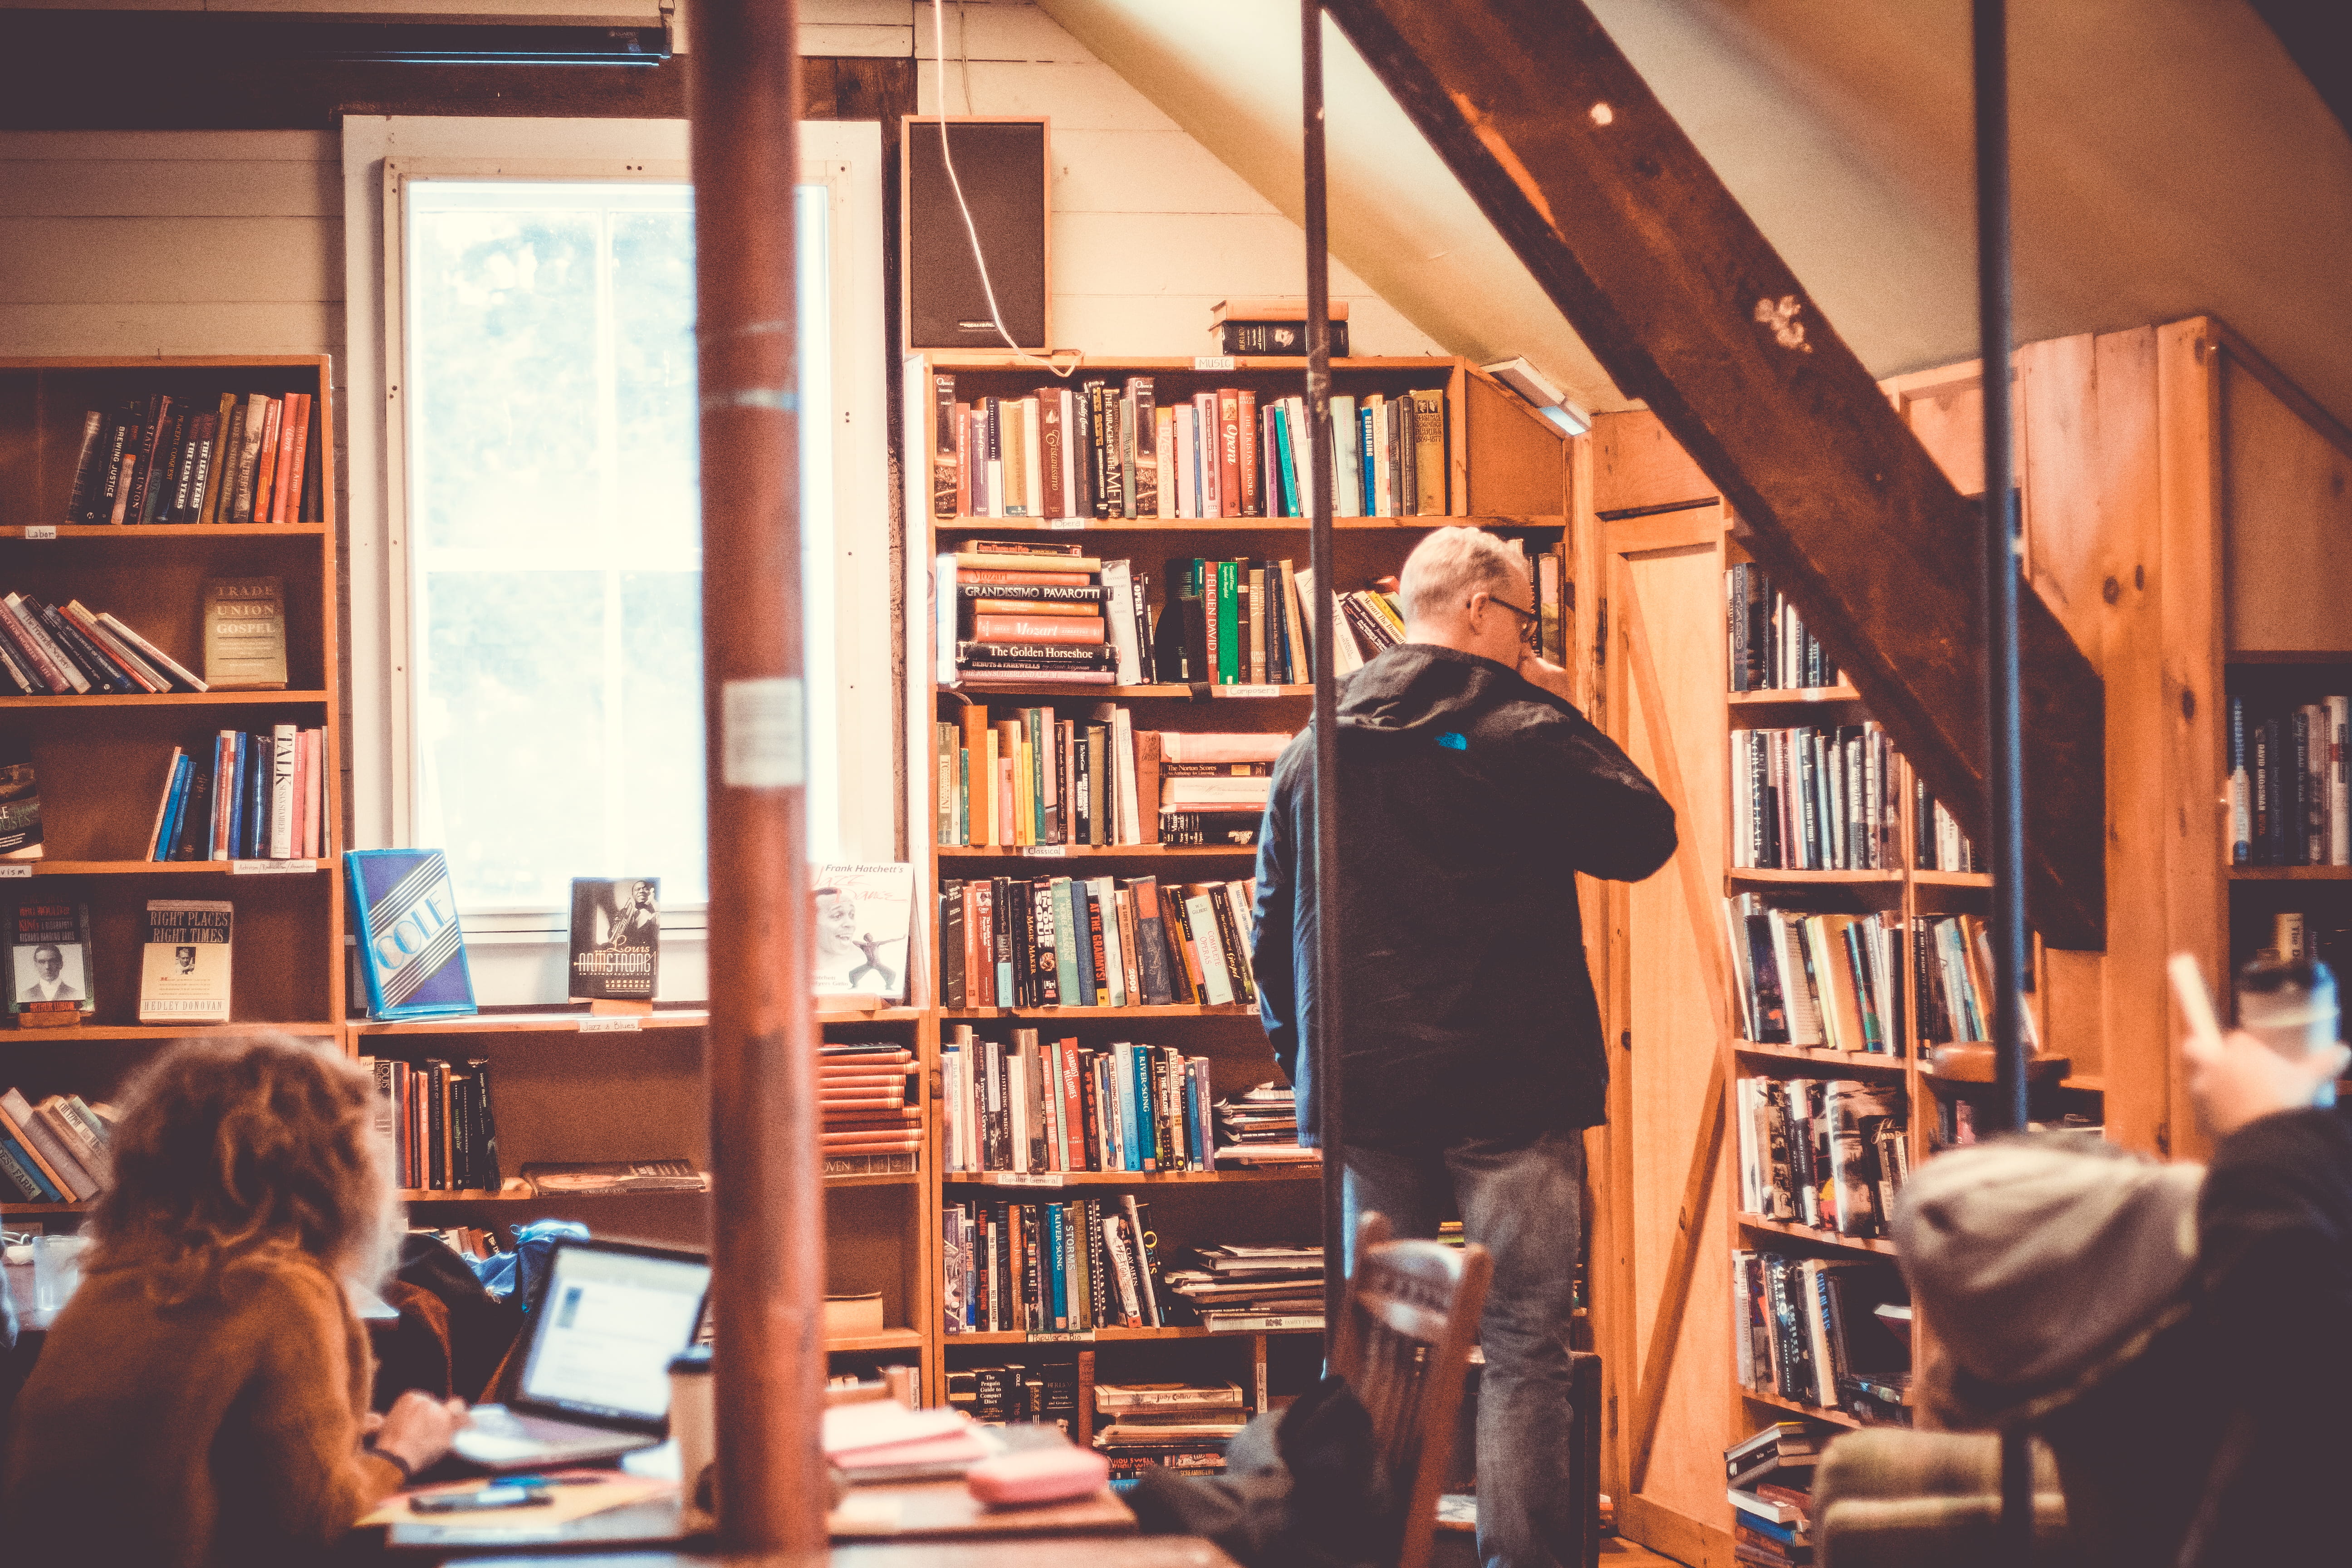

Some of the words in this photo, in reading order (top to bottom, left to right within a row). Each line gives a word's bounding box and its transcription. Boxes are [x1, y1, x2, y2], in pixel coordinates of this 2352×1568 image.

[1199, 359, 1230, 368] MUSIC
[113, 426, 125, 462] BREWING
[144, 425, 155, 453] STATE
[296, 432, 304, 446] the
[1159, 427, 1171, 456] BIZET
[1222, 424, 1239, 465] Opera
[1245, 431, 1254, 466] TRISTAN
[1364, 416, 1373, 456] REBUILDING
[186, 441, 196, 459] THE
[201, 441, 210, 459] THE
[292, 446, 304, 472] Floating
[1045, 430, 1062, 490] Tristanissimo
[1107, 444, 1113, 455] OF
[1375, 437, 1383, 464] LEGACY
[107, 464, 118, 498] JUSTICE
[182, 460, 191, 482] LEAN
[197, 460, 206, 481] LEAN
[290, 473, 299, 493] Army
[132, 476, 144, 508] UNION
[177, 483, 187, 509] YEARS
[192, 482, 203, 509] YEARS
[1106, 470, 1122, 508] MET
[27, 529, 54, 539] Labor
[974, 573, 1007, 581] Mozart
[216, 586, 274, 596] TRADE
[965, 587, 1039, 597] GRANDISSIMO
[1044, 588, 1100, 598] PAVAROTTI
[1132, 584, 1143, 616] OPERA
[1206, 573, 1217, 616] FÉLICIEN
[217, 605, 274, 615] UNION
[1735, 565, 1744, 650] BRANDO
[21, 611, 37, 627] The
[31, 623, 56, 651] Friendly
[49, 646, 73, 671] Society
[216, 623, 275, 633] GOSPEL
[1016, 623, 1058, 636] Mozart
[1206, 618, 1218, 651] DAVID
[989, 647, 1008, 656] The
[1009, 647, 1044, 657] Golden
[1045, 647, 1093, 658] Horseshoe
[1339, 633, 1352, 661] DAVENPORT
[274, 733, 294, 787] TALK
[1750, 736, 1760, 800] NORMAN
[277, 804, 285, 835] STAMBERG
[1753, 802, 1761, 849] LEAR
[1028, 847, 1061, 855] Classical
[855, 865, 904, 873] Hatchett's
[832, 887, 908, 903] Dance
[1040, 890, 1048, 910] IN
[1089, 902, 1099, 913] AT
[151, 911, 184, 926] RIGHT
[188, 912, 228, 926] PLACES
[376, 890, 453, 970] COLE
[1027, 915, 1035, 943] MAGIC
[1034, 891, 1044, 948] SOUL
[1090, 915, 1101, 932] THE
[153, 928, 186, 943] RIGHT
[191, 929, 223, 943] TIMES
[607, 935, 650, 953] Louis
[1207, 930, 1221, 967] COMPLETE
[579, 951, 651, 972] ARMSTRONG
[1028, 944, 1037, 974] MAKER
[1092, 934, 1105, 982] GRAMMYS!
[1198, 936, 1212, 965] OPERAS
[1127, 968, 1137, 992] 2000
[145, 1001, 179, 1010] HEDLEY
[183, 1001, 222, 1010] DONOVAN
[583, 1022, 601, 1031] Jazz
[614, 1021, 635, 1029] Blues
[380, 1063, 390, 1088] LOUIS
[1043, 1060, 1051, 1086] NEVELL
[1063, 1049, 1080, 1077] STARDUST
[1138, 1056, 1148, 1084] RIVER
[1169, 1054, 1179, 1092] EVERYBODY
[953, 1080, 958, 1088] OF
[1062, 1069, 1078, 1099] MELODIES
[1044, 1098, 1054, 1114] TIME
[1141, 1086, 1150, 1112] SONG
[1171, 1093, 1181, 1114] HURTS
[1047, 1126, 1057, 1144] DANCE
[1002, 1175, 1027, 1184] Popular
[1030, 1175, 1058, 1184] General
[1053, 1214, 1063, 1241] RIVER
[1054, 1245, 1064, 1270] SONG
[1064, 1225, 1077, 1270] STORMS
[1125, 1247, 1134, 1264] CLAY
[1142, 1230, 1162, 1275] Oasis
[1129, 1264, 1139, 1286] AIKEN
[1156, 1393, 1171, 1403] Judy
